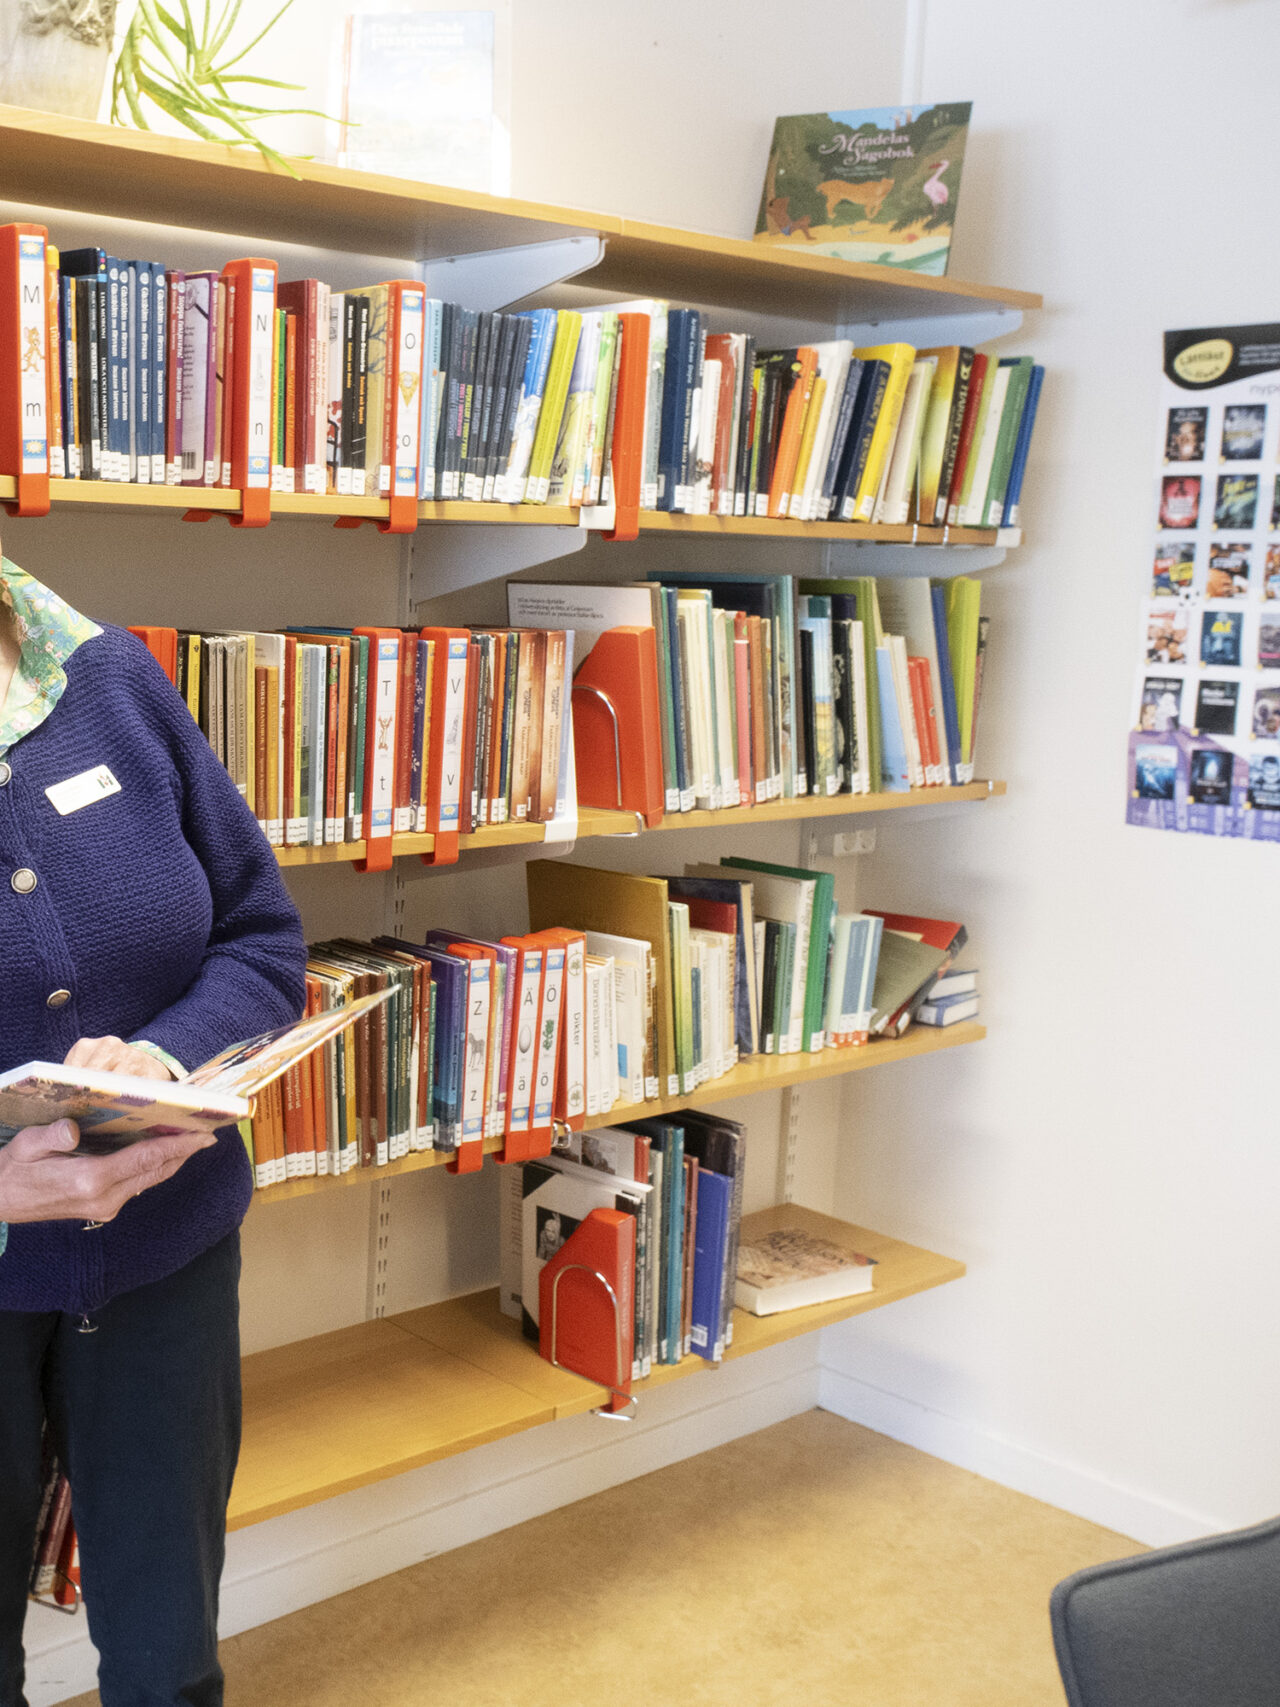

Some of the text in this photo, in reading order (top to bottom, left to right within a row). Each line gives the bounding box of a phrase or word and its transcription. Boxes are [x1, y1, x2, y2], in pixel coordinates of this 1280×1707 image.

[818, 132, 910, 154] Mandelas
[843, 146, 913, 166] Sagobok
[23, 286, 41, 304] M
[256, 314, 267, 332] N
[404, 332, 416, 349] O
[26, 401, 42, 417] m
[255, 422, 263, 435] n
[946, 385, 969, 484] HARRY POTTER
[402, 434, 410, 448] o
[382, 680, 391, 696] T
[451, 678, 460, 694] V
[380, 777, 385, 790] t
[447, 774, 454, 786] v
[523, 987, 533, 1006] Ä
[546, 984, 556, 1002] Ö
[474, 1000, 483, 1015] Z
[518, 1078, 526, 1090] ä
[540, 1072, 548, 1086] ö
[470, 1090, 477, 1101] z
